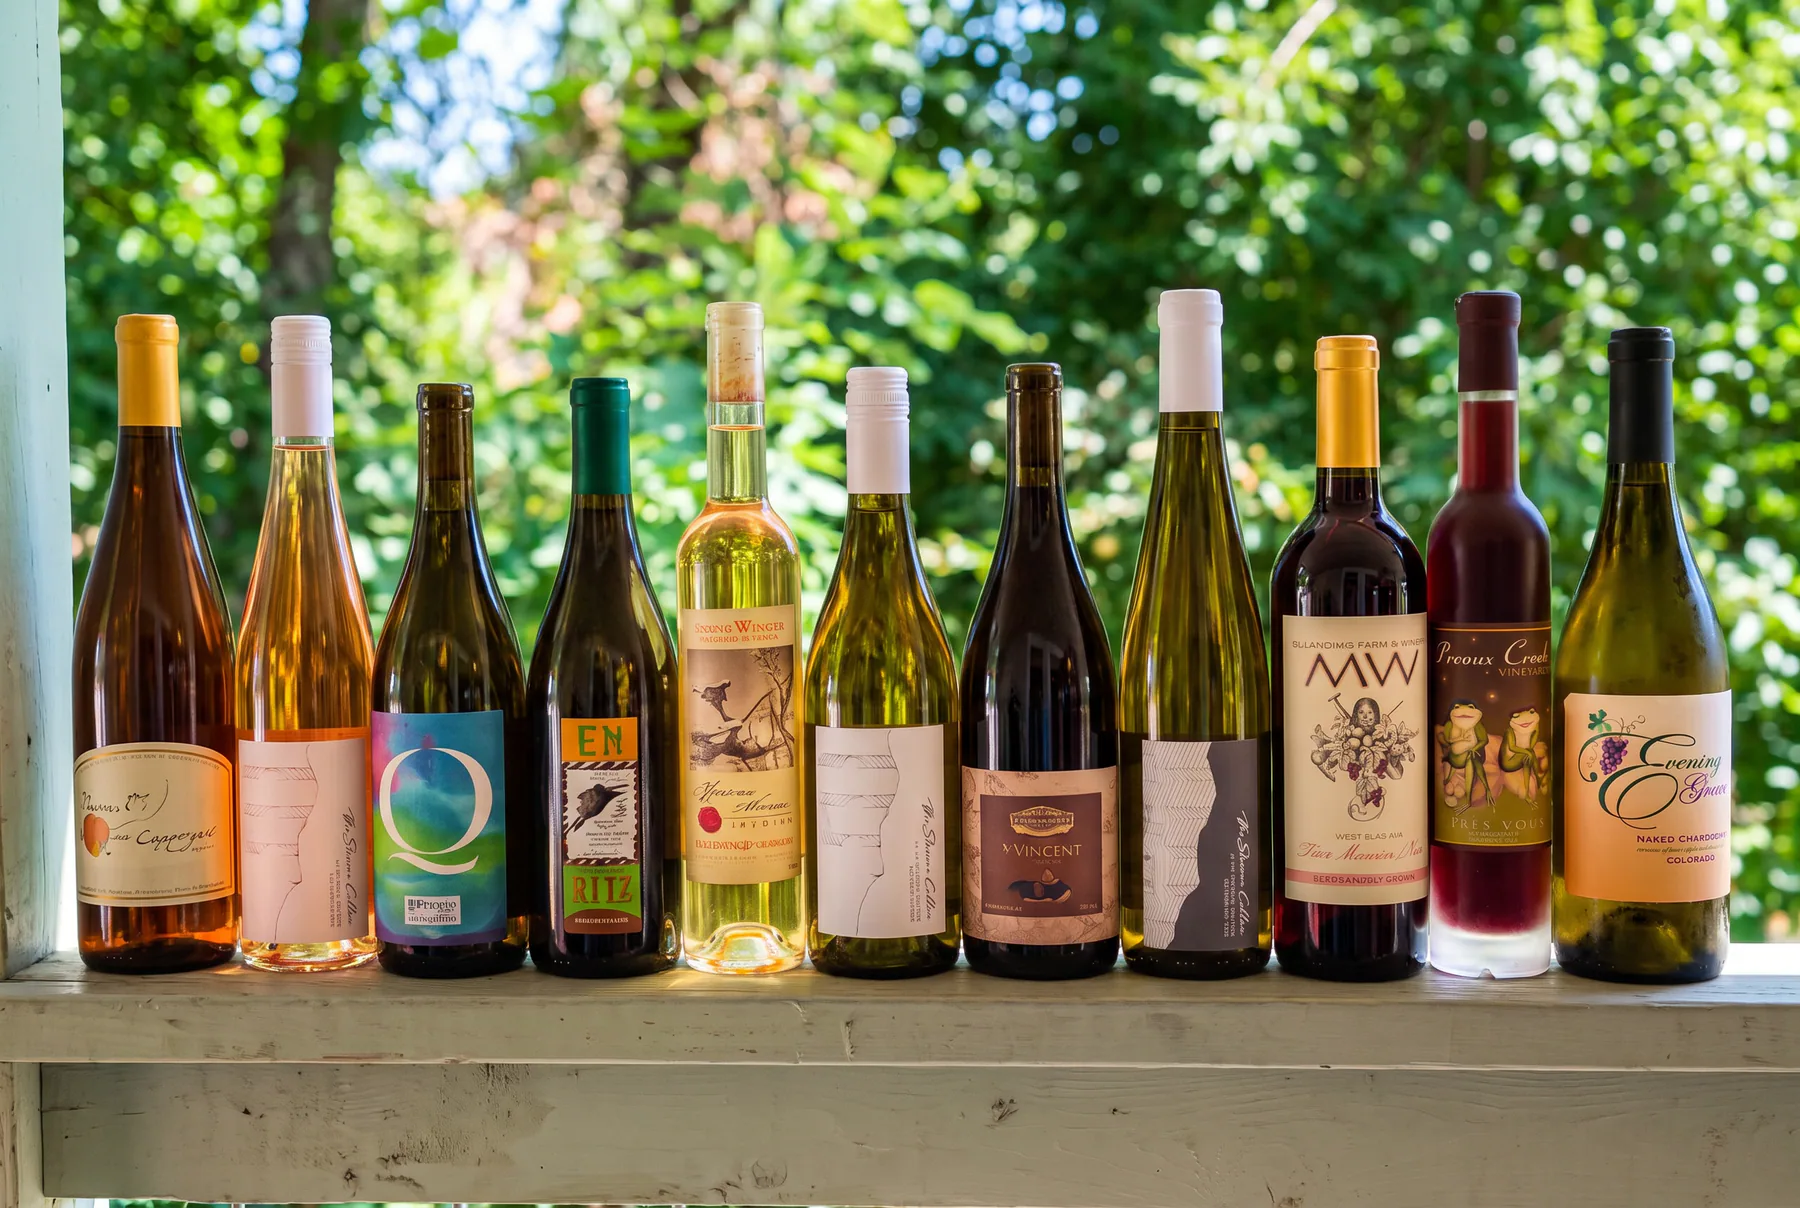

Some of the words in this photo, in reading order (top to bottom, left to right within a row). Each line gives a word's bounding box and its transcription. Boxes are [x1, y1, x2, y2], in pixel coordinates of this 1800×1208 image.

[733, 620, 785, 634] WINGER
[1357, 641, 1388, 649] FARM
[1390, 640, 1399, 648] &
[577, 725, 624, 756] EN
[379, 747, 493, 876] Q
[1502, 818, 1544, 830] VOUS
[1335, 833, 1362, 841] WEST
[1637, 835, 1675, 843] NAKED
[1667, 854, 1716, 865] COLORADO
[1385, 874, 1416, 883] GROWN
[572, 876, 633, 904] RITZ
